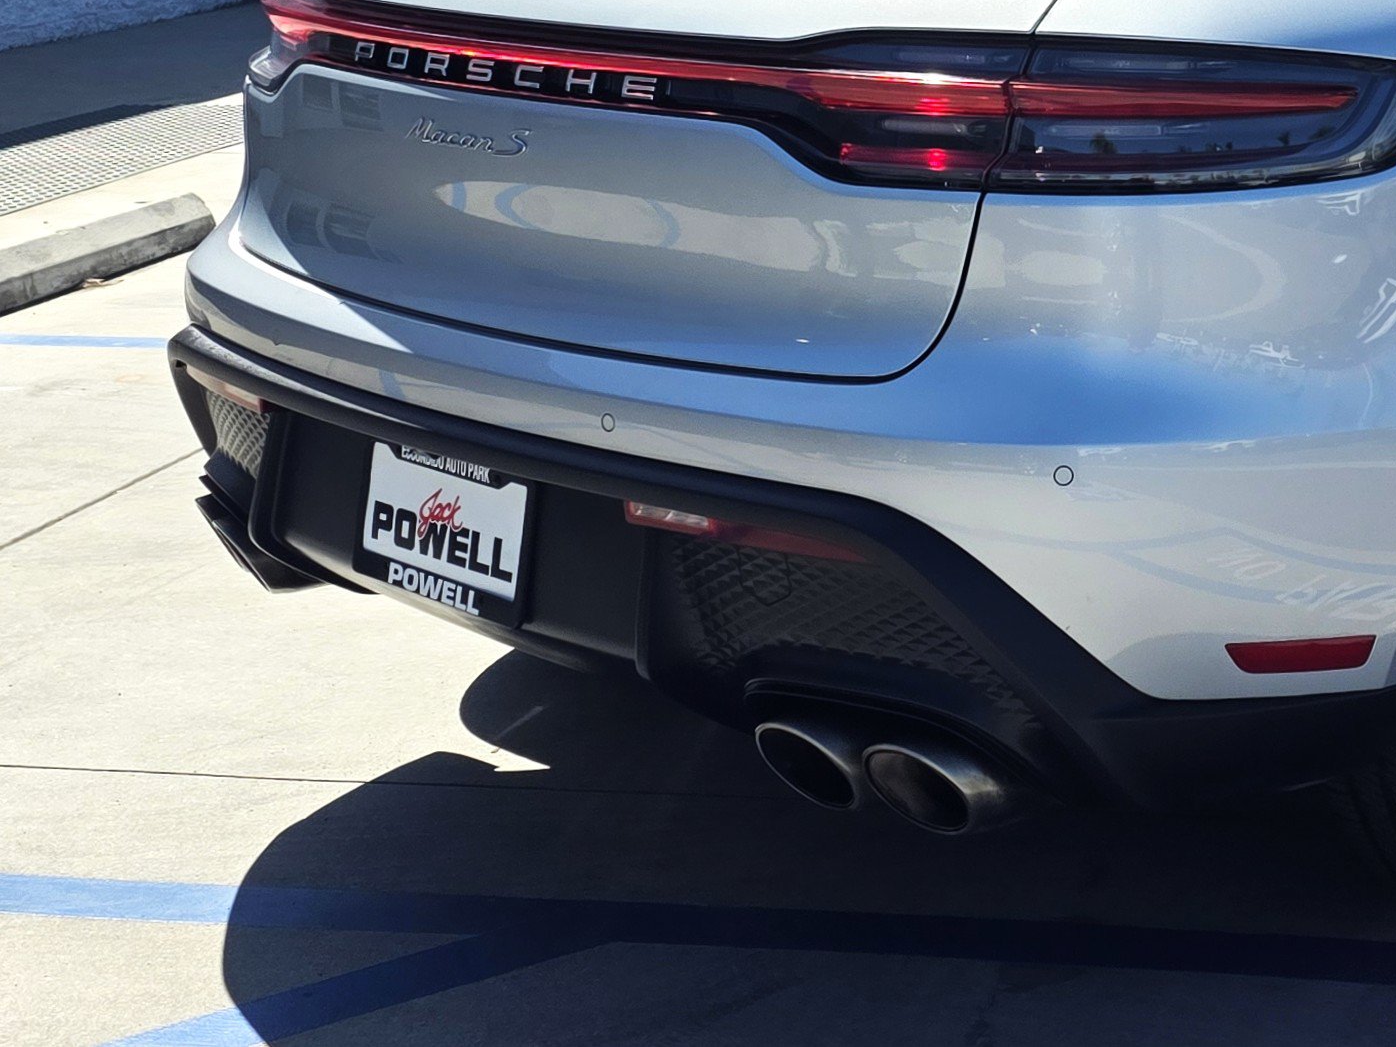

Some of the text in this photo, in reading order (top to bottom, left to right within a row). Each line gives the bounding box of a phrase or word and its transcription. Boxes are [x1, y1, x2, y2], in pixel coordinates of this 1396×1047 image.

[354, 41, 657, 101] PORSCHE
[405, 116, 532, 157] Macan S
[445, 457, 467, 476] AUTO
[467, 462, 490, 484] PARK
[417, 488, 463, 538] Jack
[371, 500, 513, 584] POWELL
[387, 561, 480, 616] POWELL
